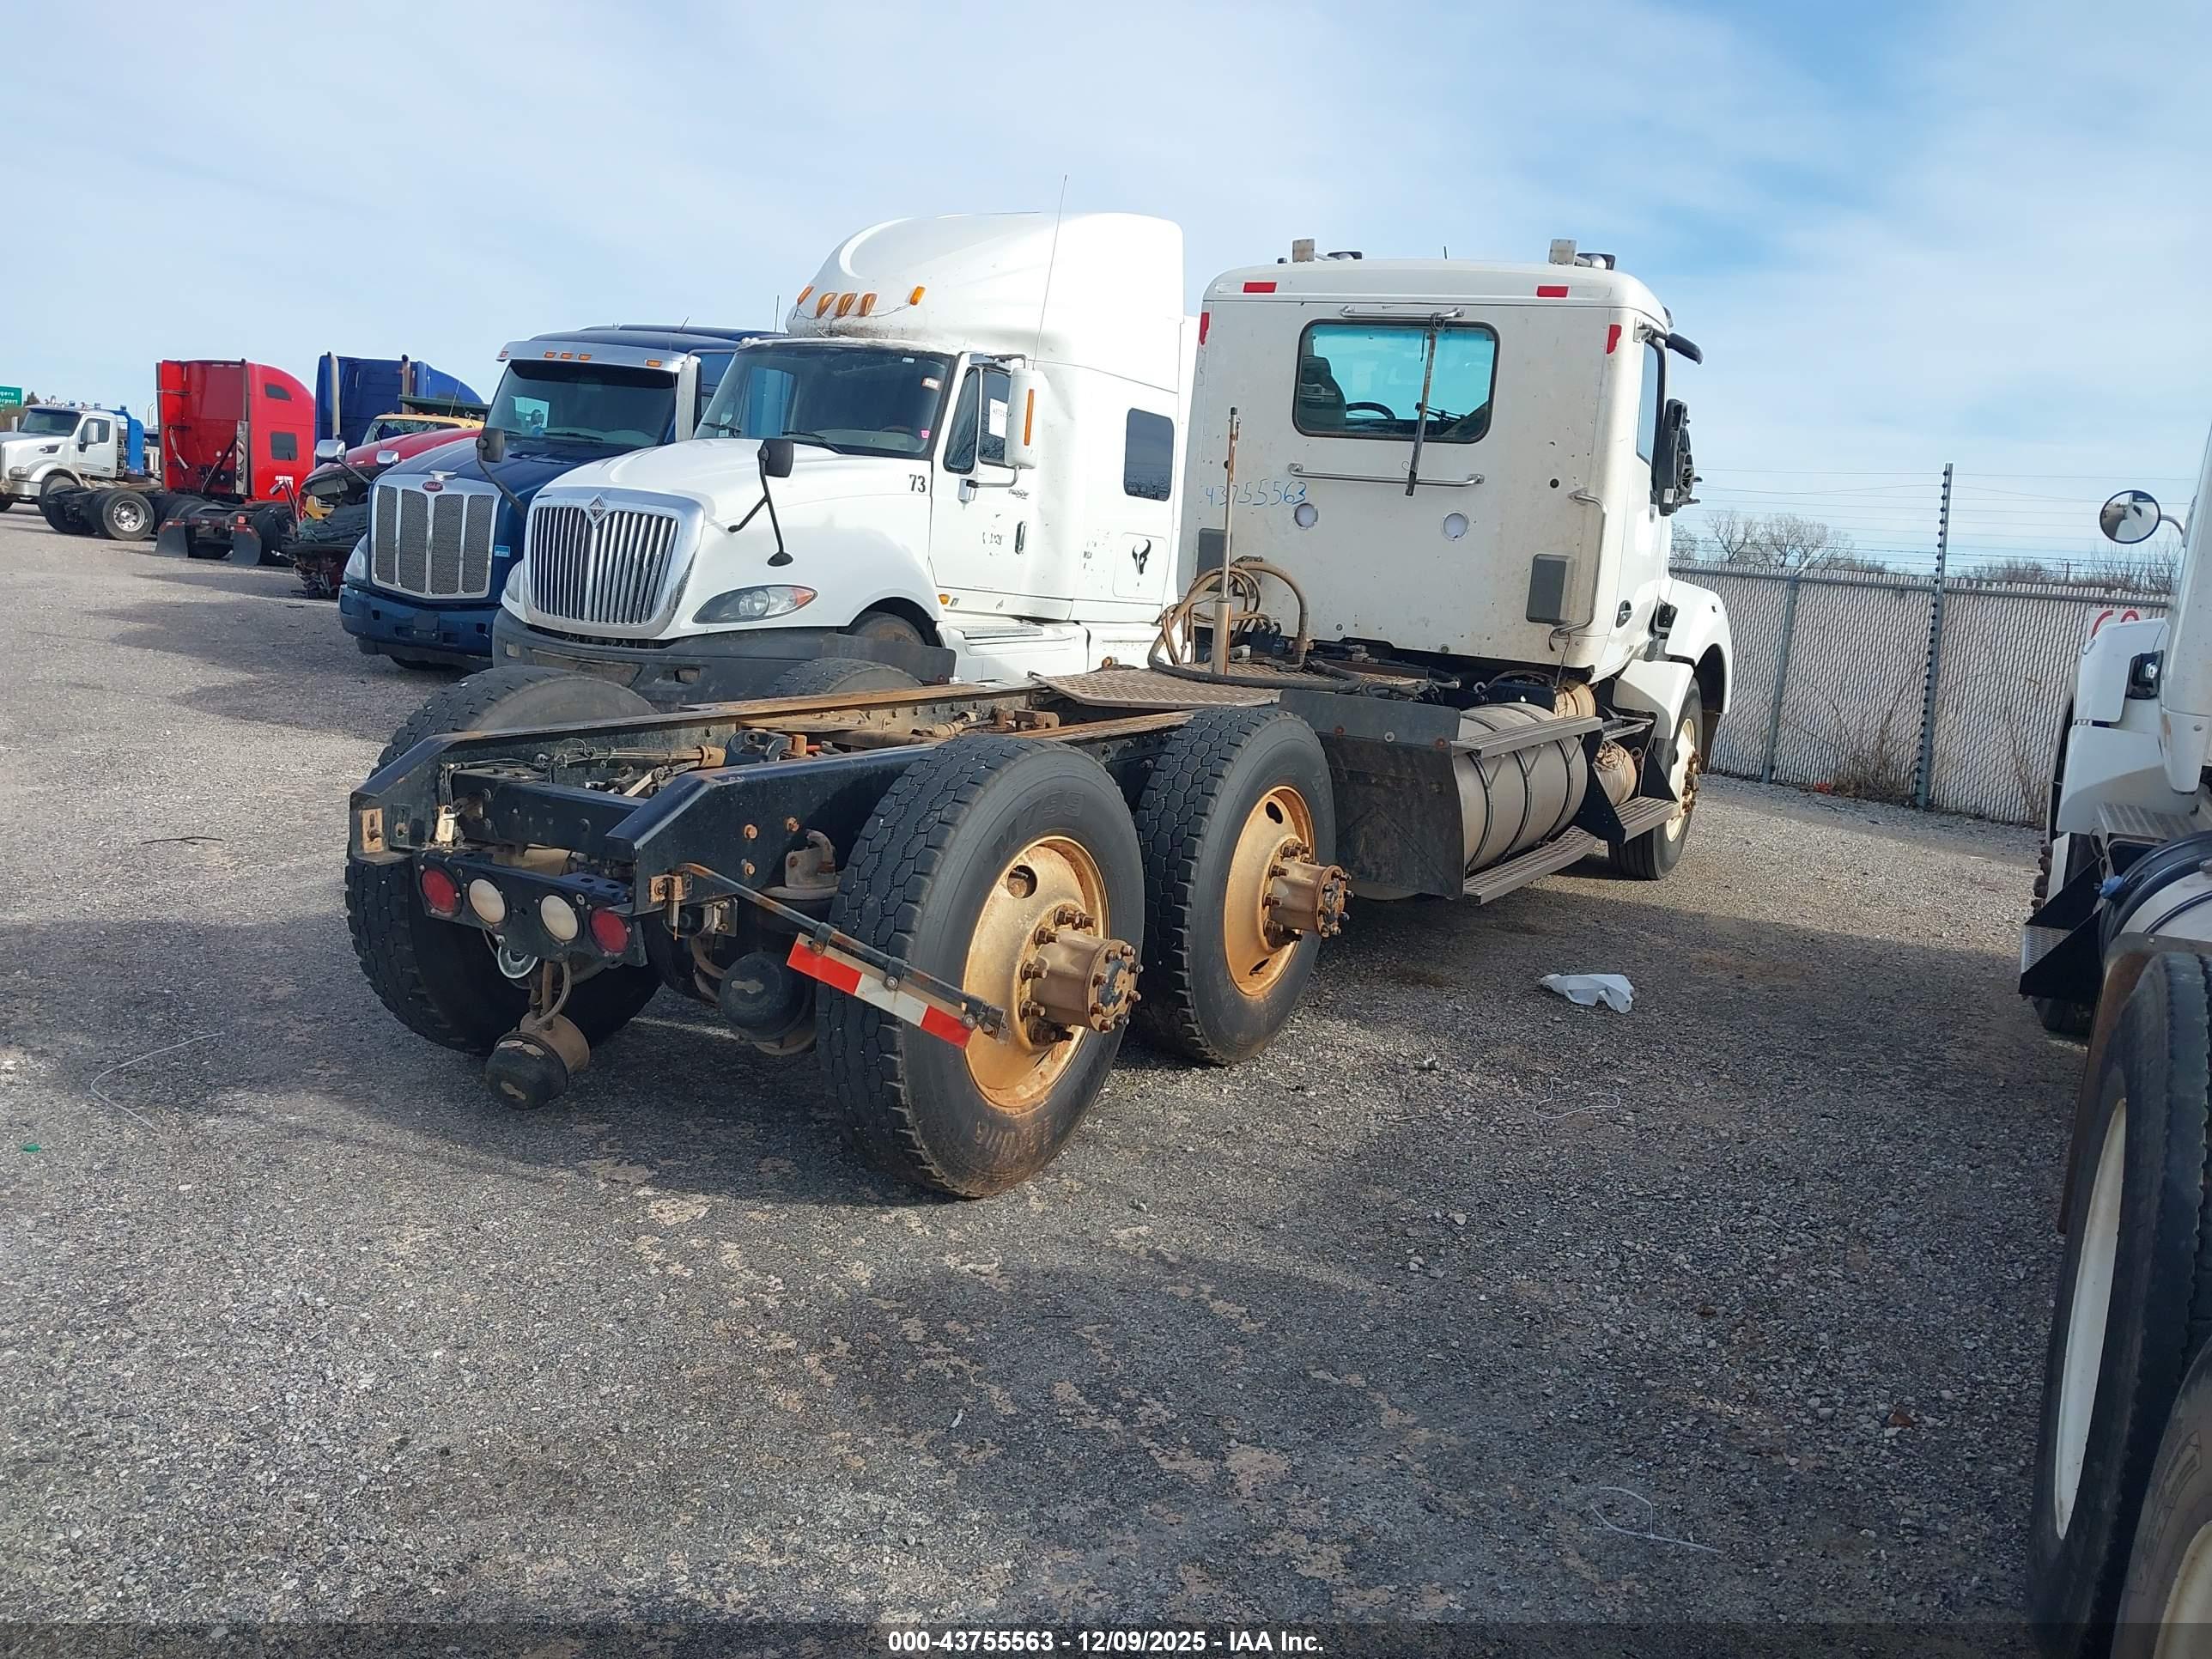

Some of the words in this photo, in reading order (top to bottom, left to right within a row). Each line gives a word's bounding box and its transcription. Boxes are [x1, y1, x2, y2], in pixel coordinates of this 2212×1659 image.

[909, 474, 926, 493] 73
[1206, 478, 1306, 507] 43755563
[988, 789, 1086, 867] M799
